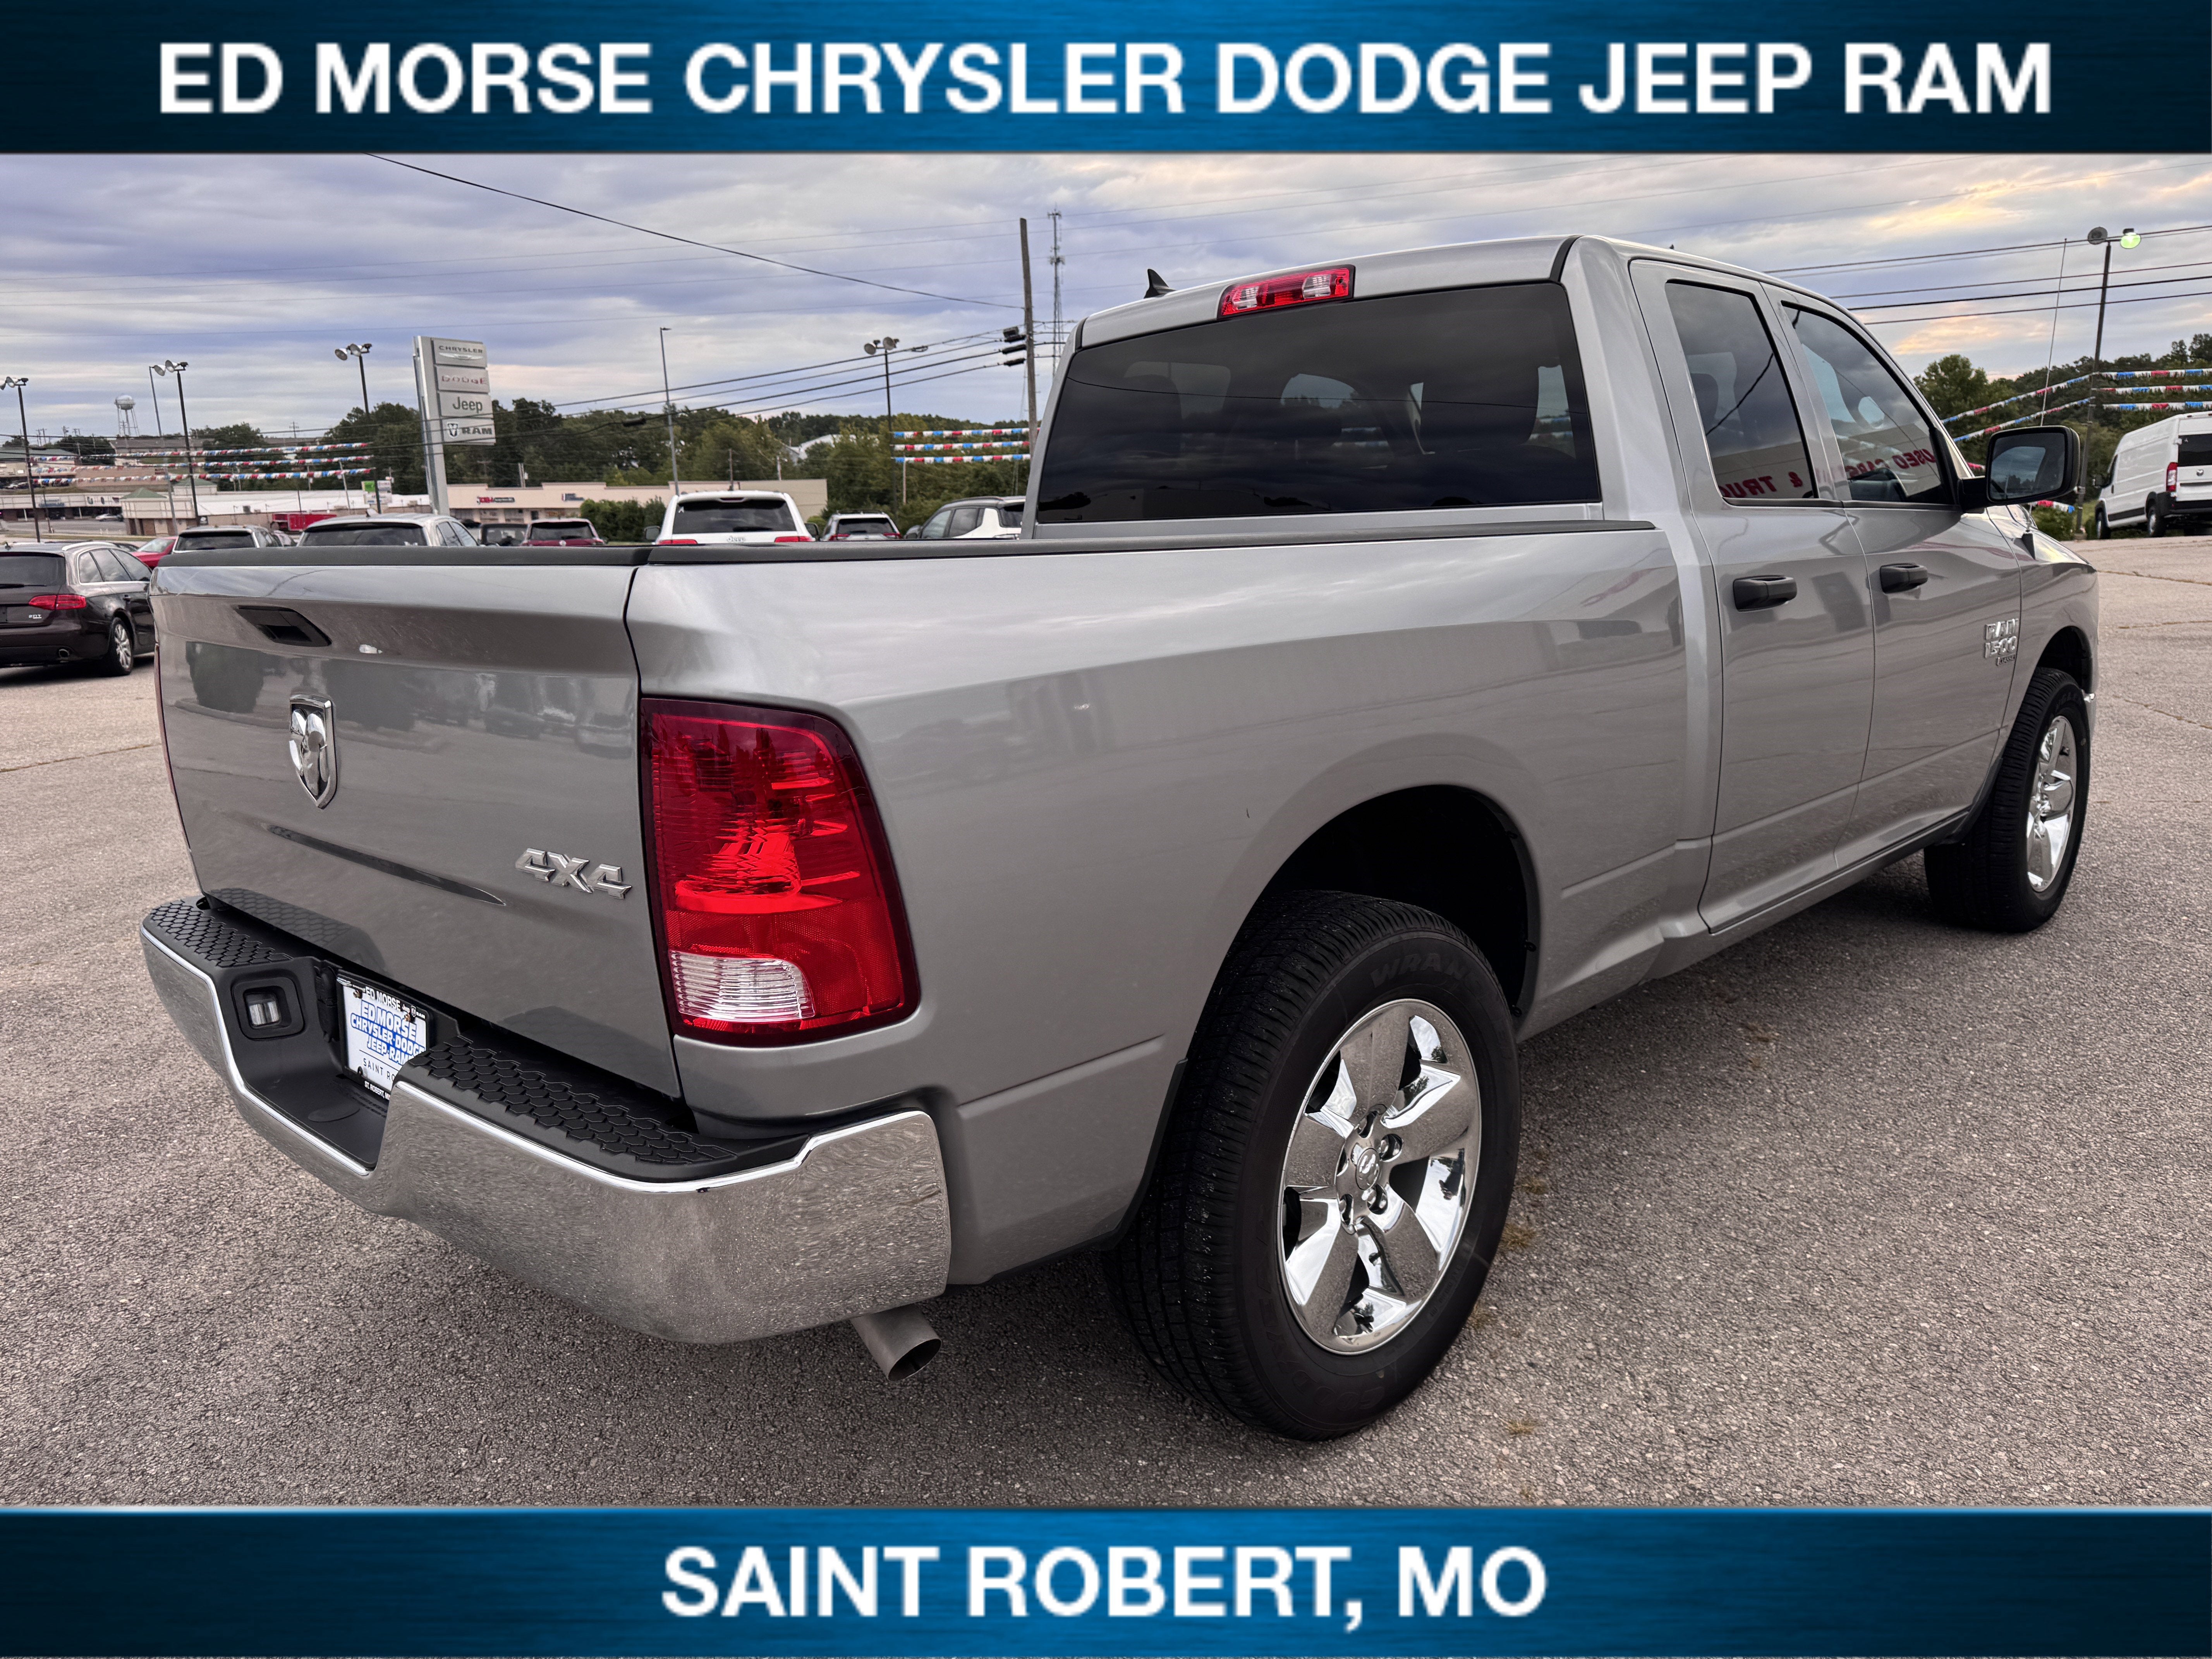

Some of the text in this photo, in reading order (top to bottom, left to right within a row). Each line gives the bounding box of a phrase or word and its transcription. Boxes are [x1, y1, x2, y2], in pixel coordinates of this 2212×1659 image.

[439, 345, 483, 353] CHRYSLER
[441, 375, 487, 385] DODGE
[452, 397, 483, 413] Jeep
[365, 986, 376, 1000] ED
[376, 990, 401, 1012] MORSE
[361, 1000, 417, 1042] ED MORSE
[364, 1058, 383, 1076] SAINT
